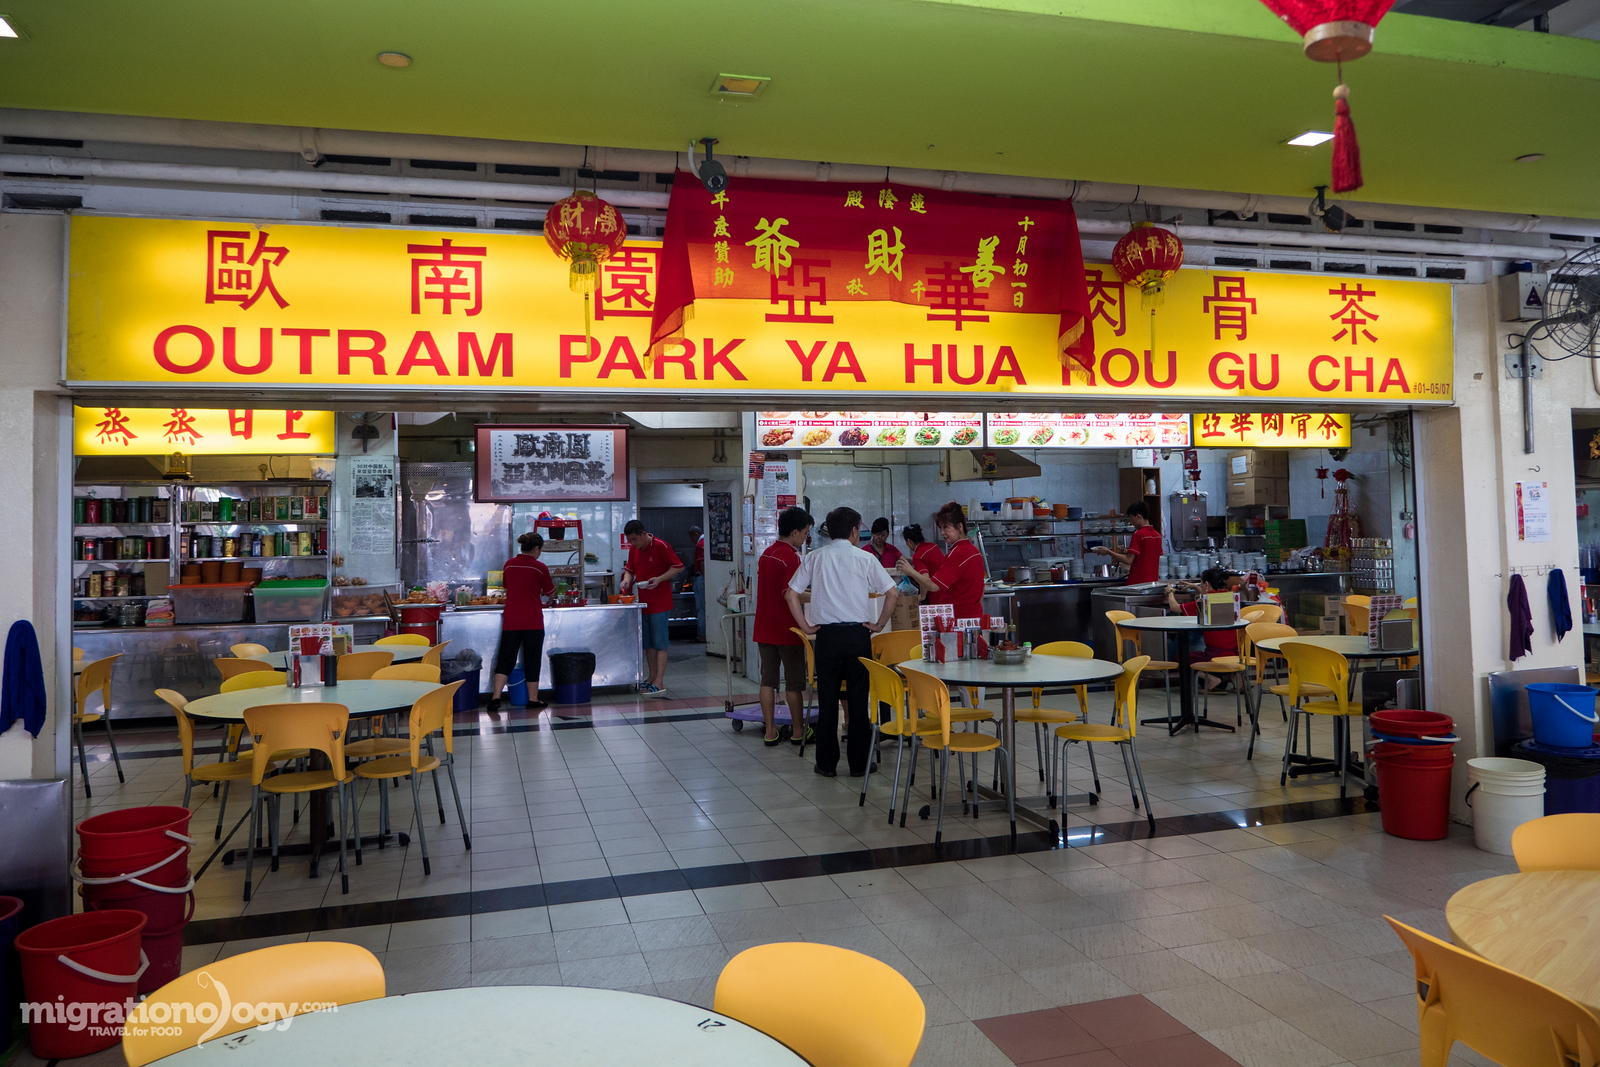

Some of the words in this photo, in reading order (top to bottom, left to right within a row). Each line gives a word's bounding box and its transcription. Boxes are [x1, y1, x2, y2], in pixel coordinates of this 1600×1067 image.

[1011, 216, 1035, 308] 十月初一日
[153, 325, 513, 377] OUTRAM
[559, 334, 749, 381] PARK
[785, 340, 867, 383] YA
[905, 343, 1027, 386] HUA
[1208, 351, 1280, 391] GU
[1308, 354, 1411, 393] CHA
